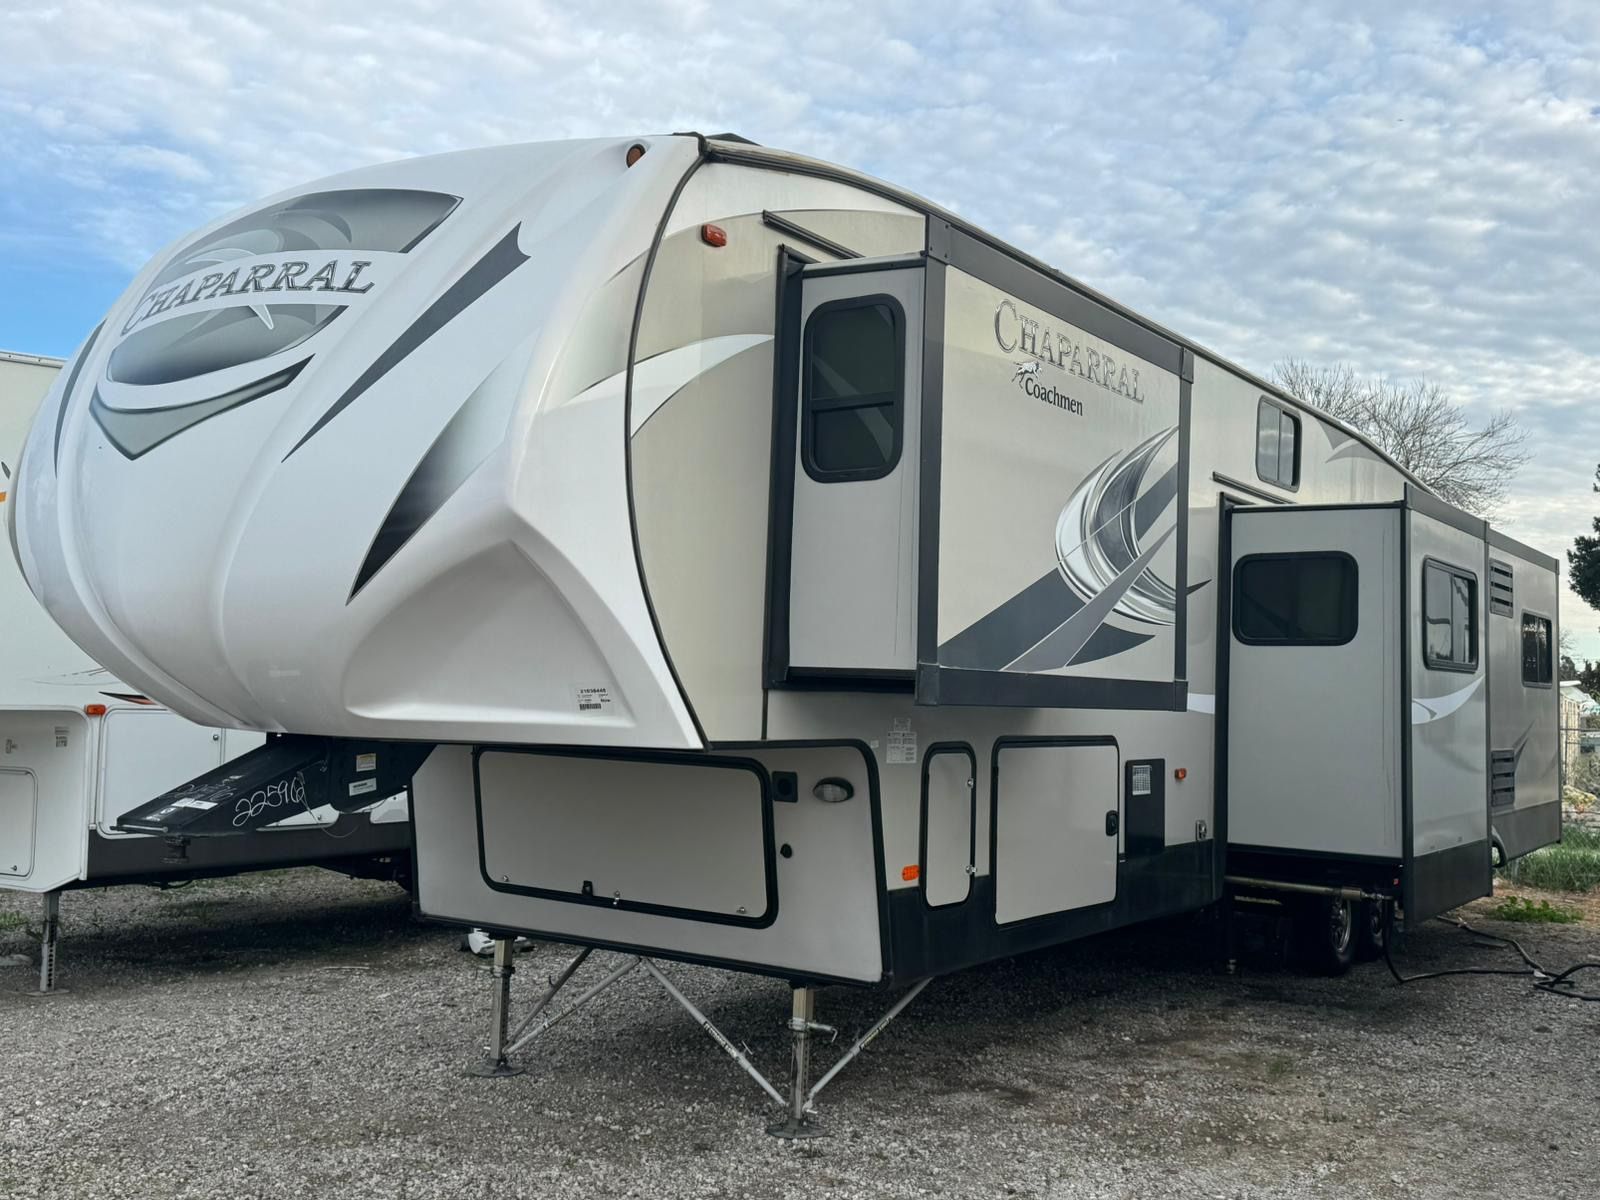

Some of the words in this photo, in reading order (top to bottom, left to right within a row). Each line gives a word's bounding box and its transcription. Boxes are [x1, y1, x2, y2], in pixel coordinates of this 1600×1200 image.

[120, 259, 374, 336] CHAPARRAL
[994, 299, 1144, 404] CHAPARRAL
[1025, 377, 1083, 417] Coachmen
